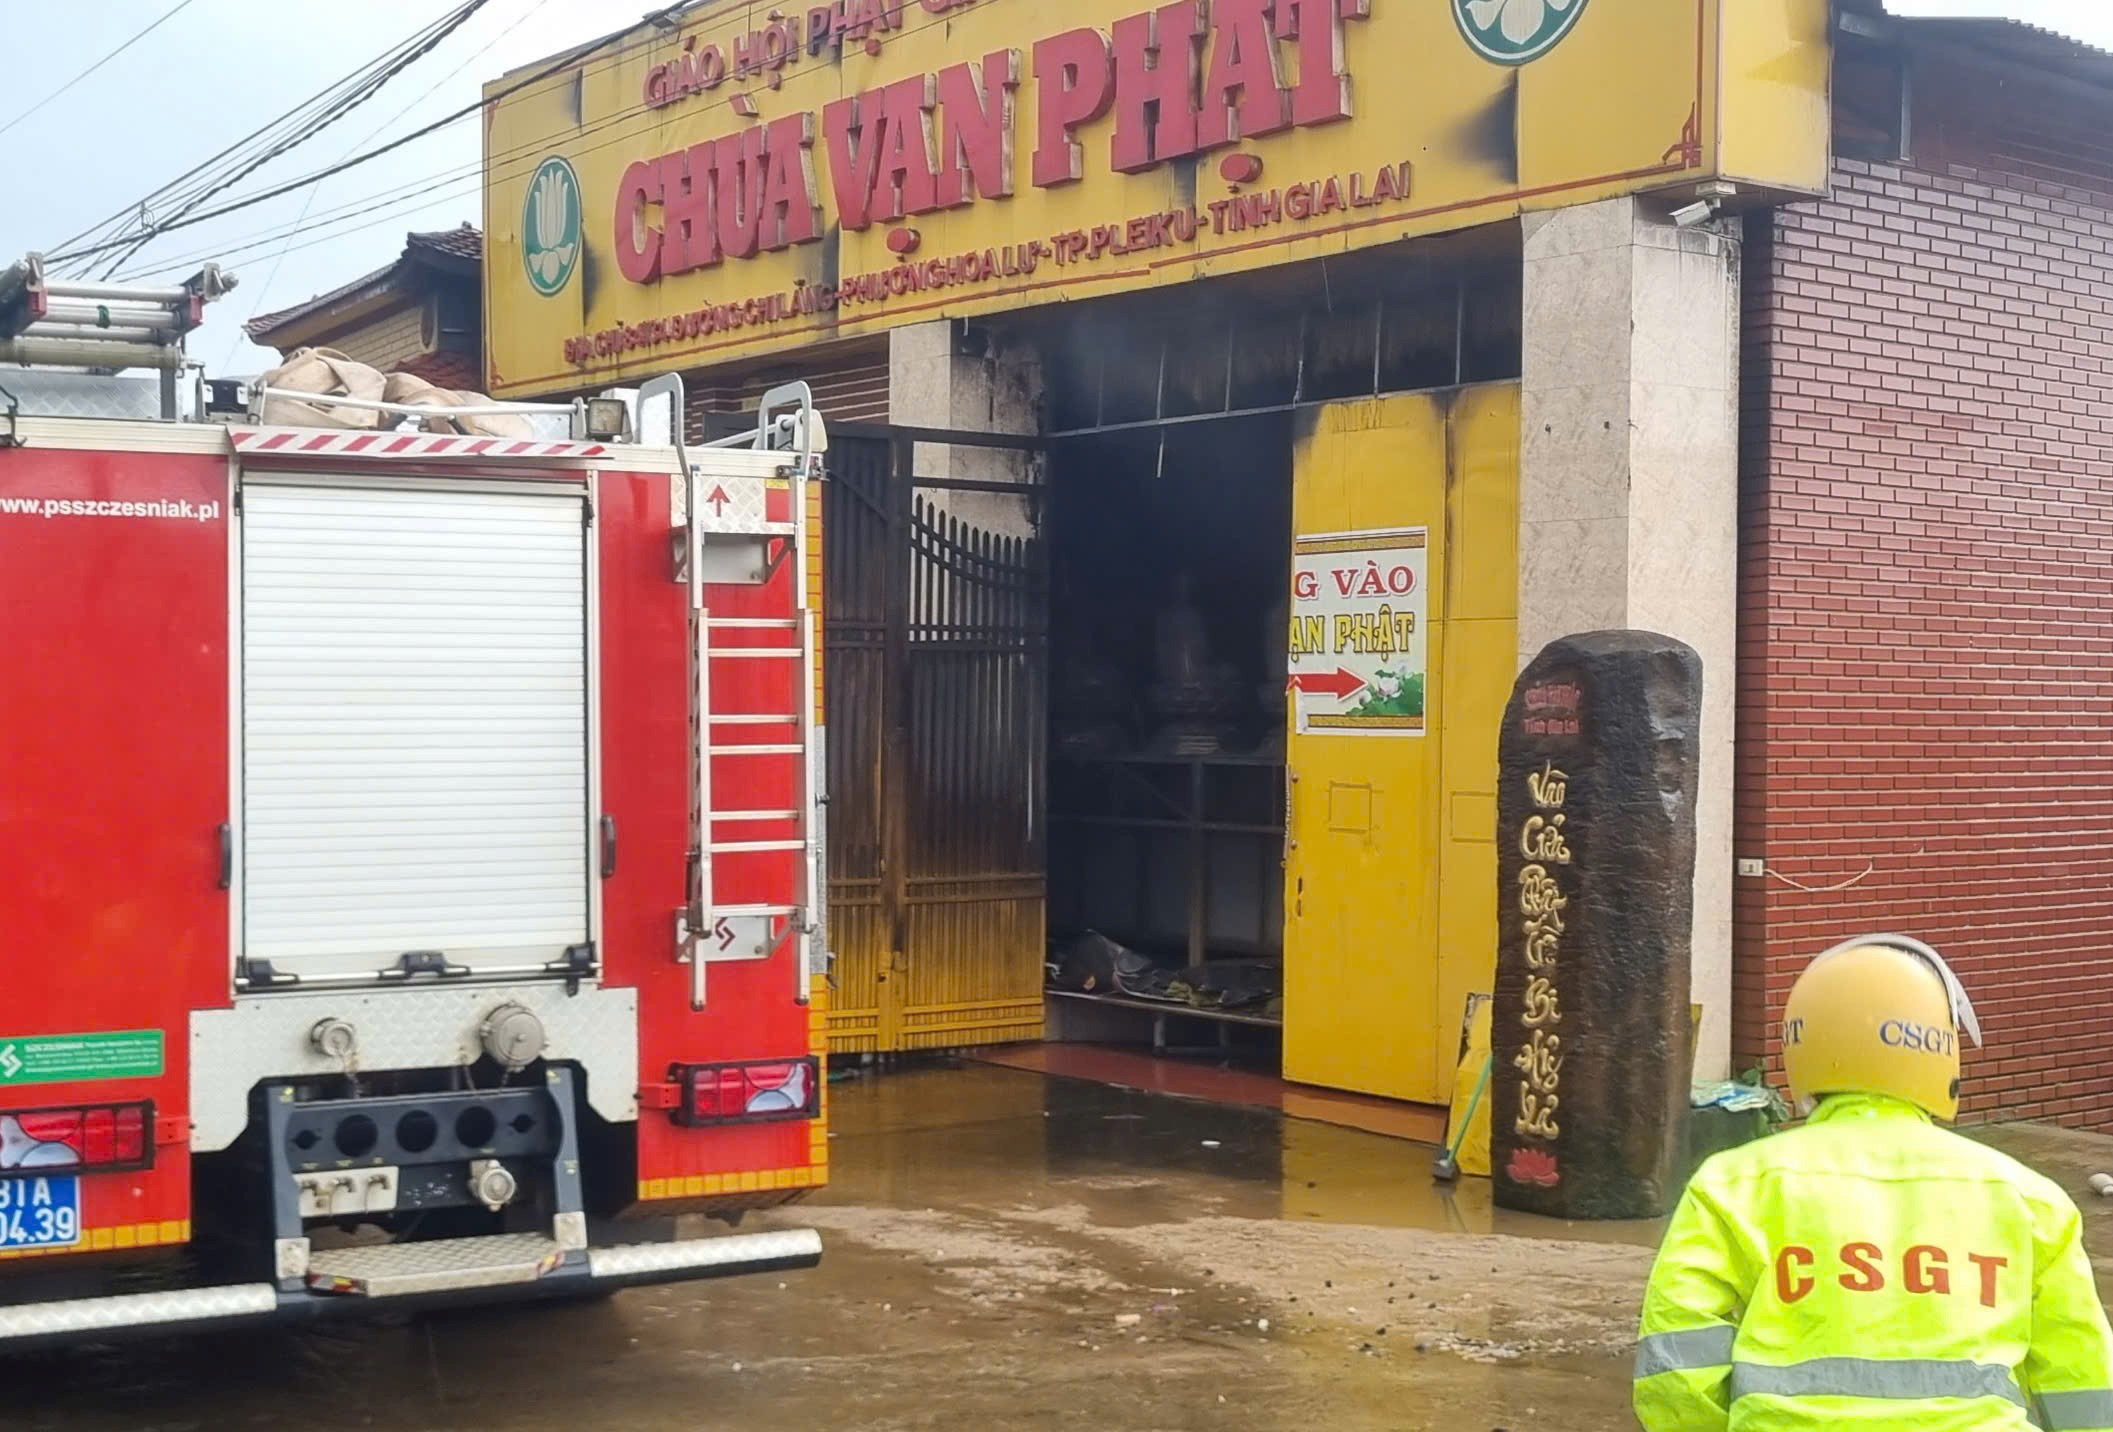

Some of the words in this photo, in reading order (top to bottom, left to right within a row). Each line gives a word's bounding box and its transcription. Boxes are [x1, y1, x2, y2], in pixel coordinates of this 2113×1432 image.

[643, 35, 725, 109] GIÁO
[733, 9, 800, 90] HỘI
[614, 93, 823, 284] CHÙA
[823, 48, 1021, 253] VẠN
[948, 248, 1001, 285] HOA
[1284, 174, 1346, 220] GIA
[1349, 160, 1412, 208] LAI
[0, 498, 219, 521] ww.psszczesniak.pl
[1331, 560, 1415, 596] VÀO
[1334, 603, 1415, 662] PHẬT
[1520, 974, 1563, 1029] Bi
[1879, 1018, 1954, 1057] CSGT
